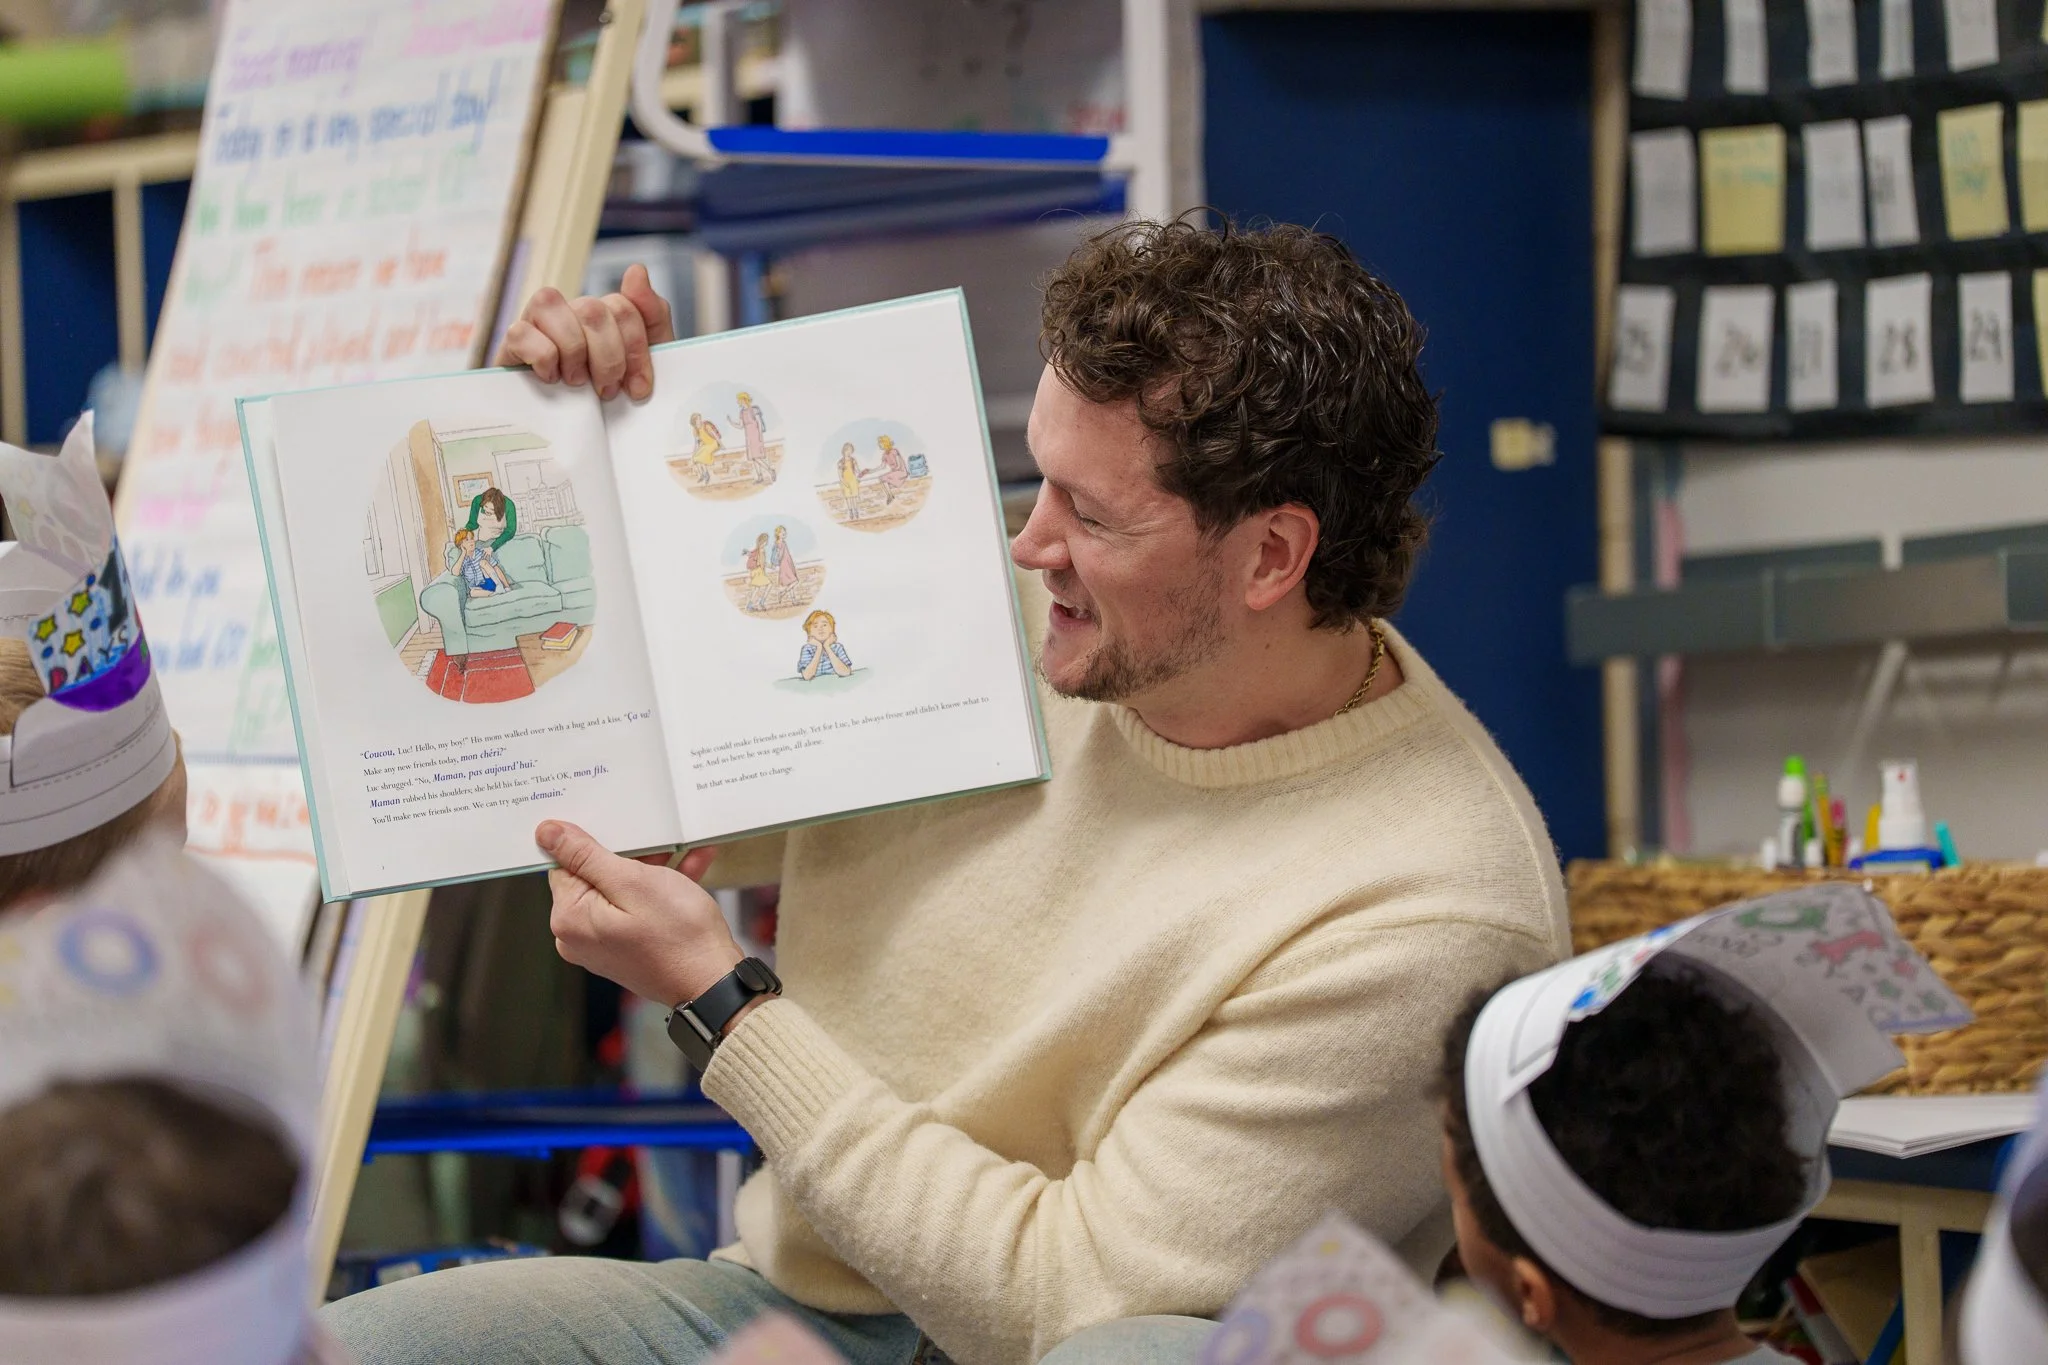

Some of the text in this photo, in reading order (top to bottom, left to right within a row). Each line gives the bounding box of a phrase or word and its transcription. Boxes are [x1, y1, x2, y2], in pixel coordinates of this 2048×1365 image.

[713, 741, 732, 752] could
[733, 738, 752, 748] make
[753, 733, 778, 744] friends
[861, 715, 884, 725] always
[905, 707, 918, 716] and
[941, 702, 961, 710] know
[962, 698, 979, 707] what
[360, 749, 396, 760] “Coucou,
[397, 746, 413, 755] Luc!
[415, 743, 437, 752] Hello,
[438, 742, 449, 751] my
[470, 736, 483, 744] His
[484, 734, 502, 742] mom
[504, 728, 529, 739] walked
[548, 724, 564, 732] with
[572, 721, 585, 730] hug
[587, 718, 600, 726] and
[363, 768, 382, 776] Make
[384, 767, 396, 775] any
[397, 763, 412, 771] new
[413, 760, 437, 769] friends
[438, 756, 459, 766] today,
[460, 753, 478, 762] mon
[705, 758, 720, 767] And
[746, 750, 756, 758] he
[771, 745, 793, 755] again,
[794, 742, 802, 750] all
[366, 784, 379, 793] Luc
[380, 780, 414, 791] shrugged.
[432, 773, 466, 782] Maman,
[468, 769, 483, 780] pas
[370, 798, 401, 808] Maman
[402, 793, 427, 804] rubbed
[428, 791, 438, 800] his
[440, 787, 473, 798] shoulders;
[474, 784, 486, 793] she
[487, 782, 502, 791] held
[502, 781, 513, 789] his
[514, 778, 530, 787] face.
[556, 772, 572, 780] OK,
[592, 765, 609, 778] fils.
[696, 783, 708, 791] But
[709, 778, 723, 788] that
[724, 776, 738, 784] was
[739, 771, 758, 782] about
[759, 769, 768, 777] to
[372, 814, 392, 825] You’ll
[393, 812, 411, 822] make
[412, 810, 427, 818] new
[428, 807, 452, 817] friends
[472, 801, 484, 809] We
[499, 798, 509, 807] try
[511, 796, 529, 806] again
